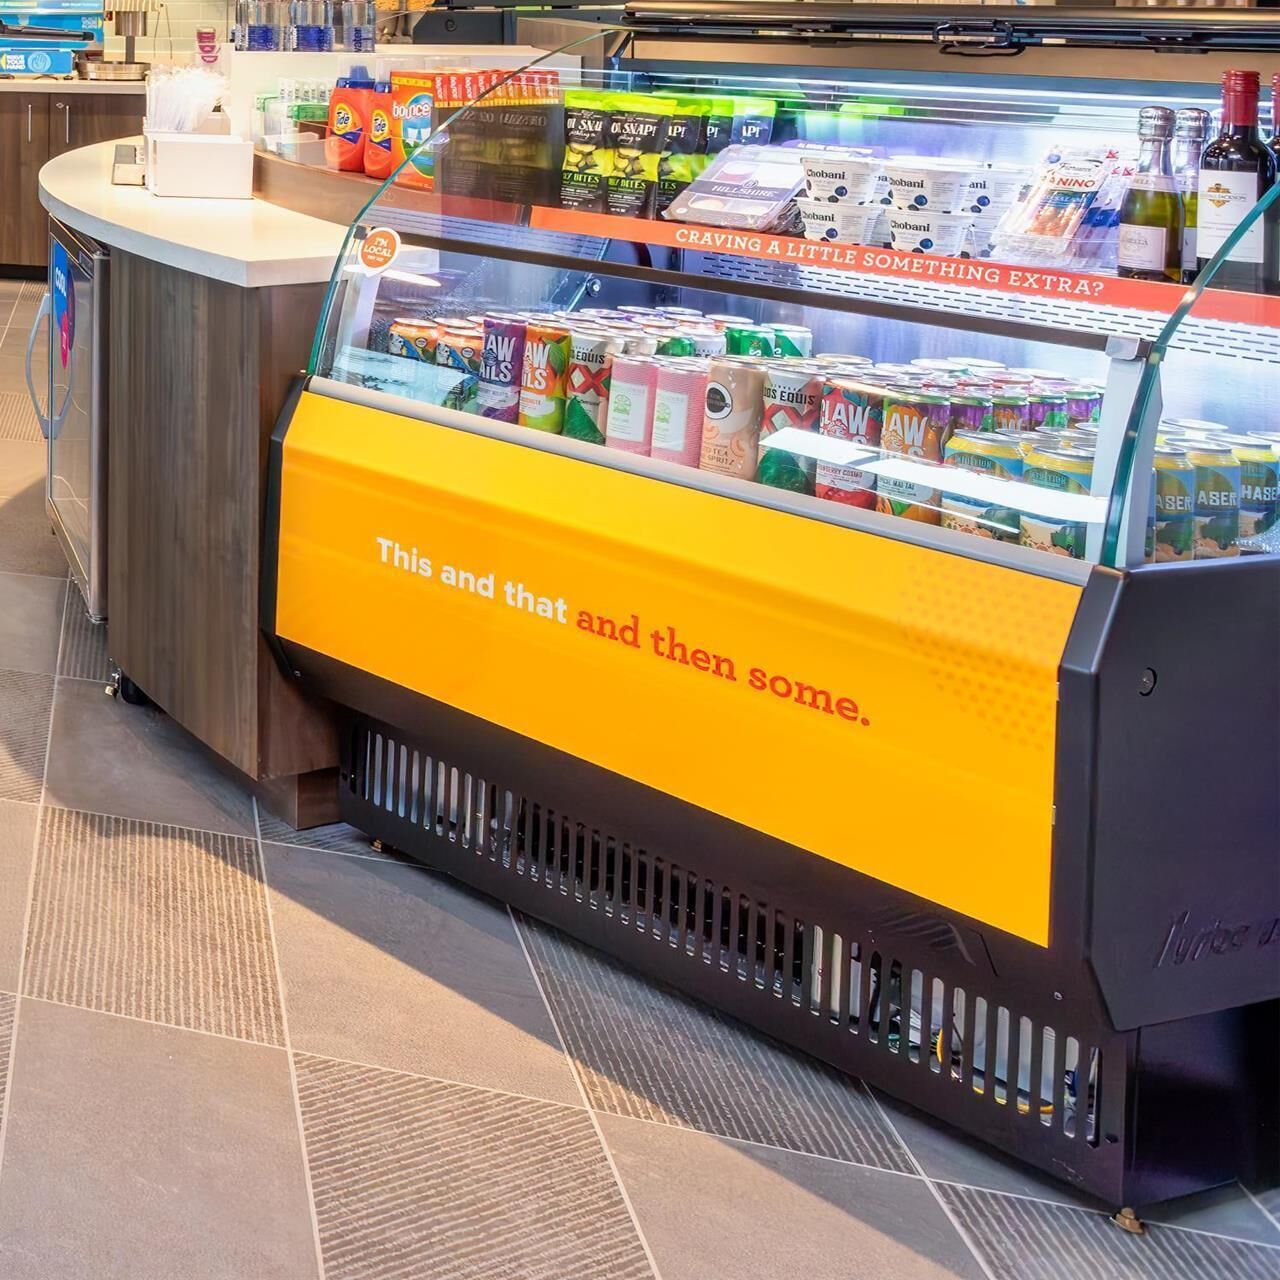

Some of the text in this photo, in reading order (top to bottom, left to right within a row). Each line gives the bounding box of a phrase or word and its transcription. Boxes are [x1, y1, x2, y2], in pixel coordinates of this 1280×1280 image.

[393, 100, 431, 119] bounce
[806, 168, 846, 180] Chobani
[712, 185, 779, 197] HILLSHIRE
[364, 245, 393, 257] LOCAL
[675, 229, 1105, 296] CRAVING A LITTLE SOMETHING EXTRA?
[576, 351, 605, 365] EQUIS
[780, 390, 816, 405] EQUIS
[376, 537, 870, 727] This and that and then some.
